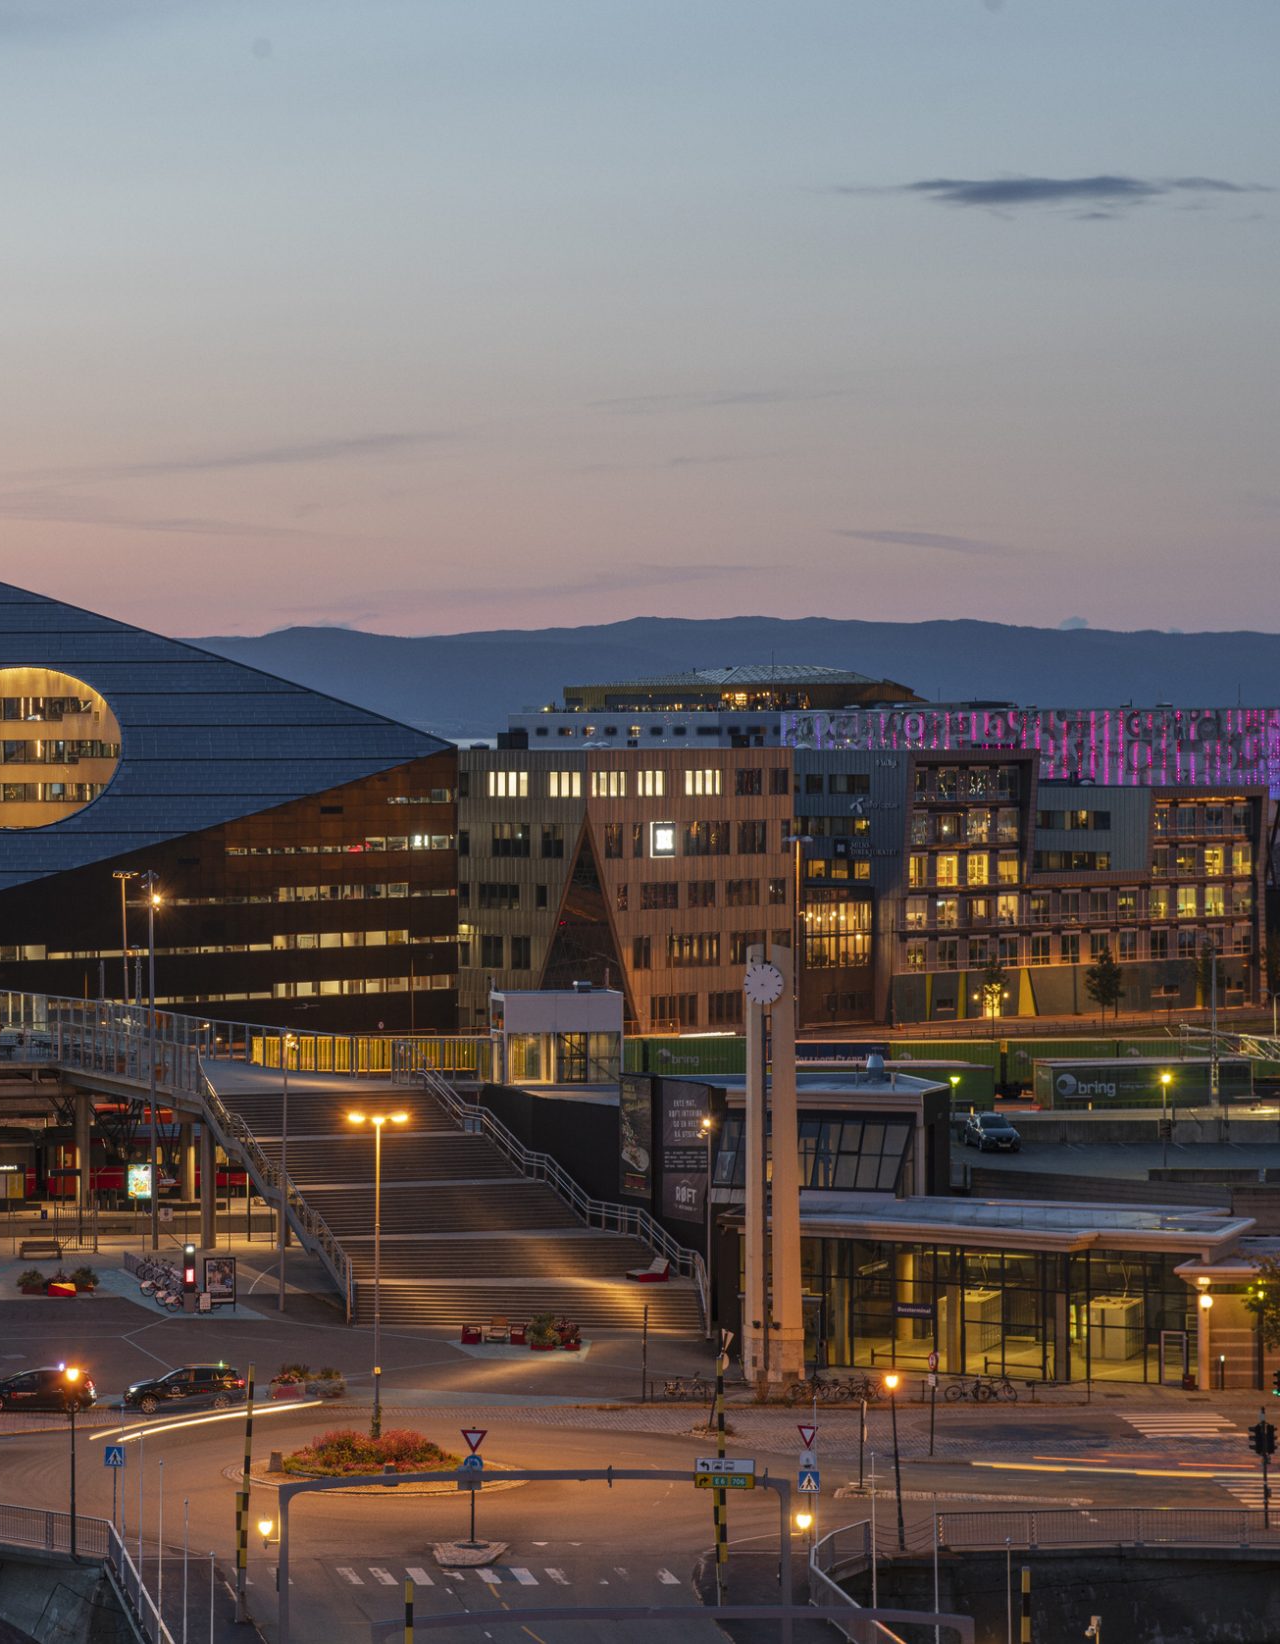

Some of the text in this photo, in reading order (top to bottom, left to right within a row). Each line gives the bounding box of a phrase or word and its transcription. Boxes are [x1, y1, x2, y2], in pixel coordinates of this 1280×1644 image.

[672, 1055, 699, 1067] bring
[1078, 1081, 1116, 1097] bring
[676, 1186, 697, 1204] RØFT
[732, 1477, 745, 1486] 706
